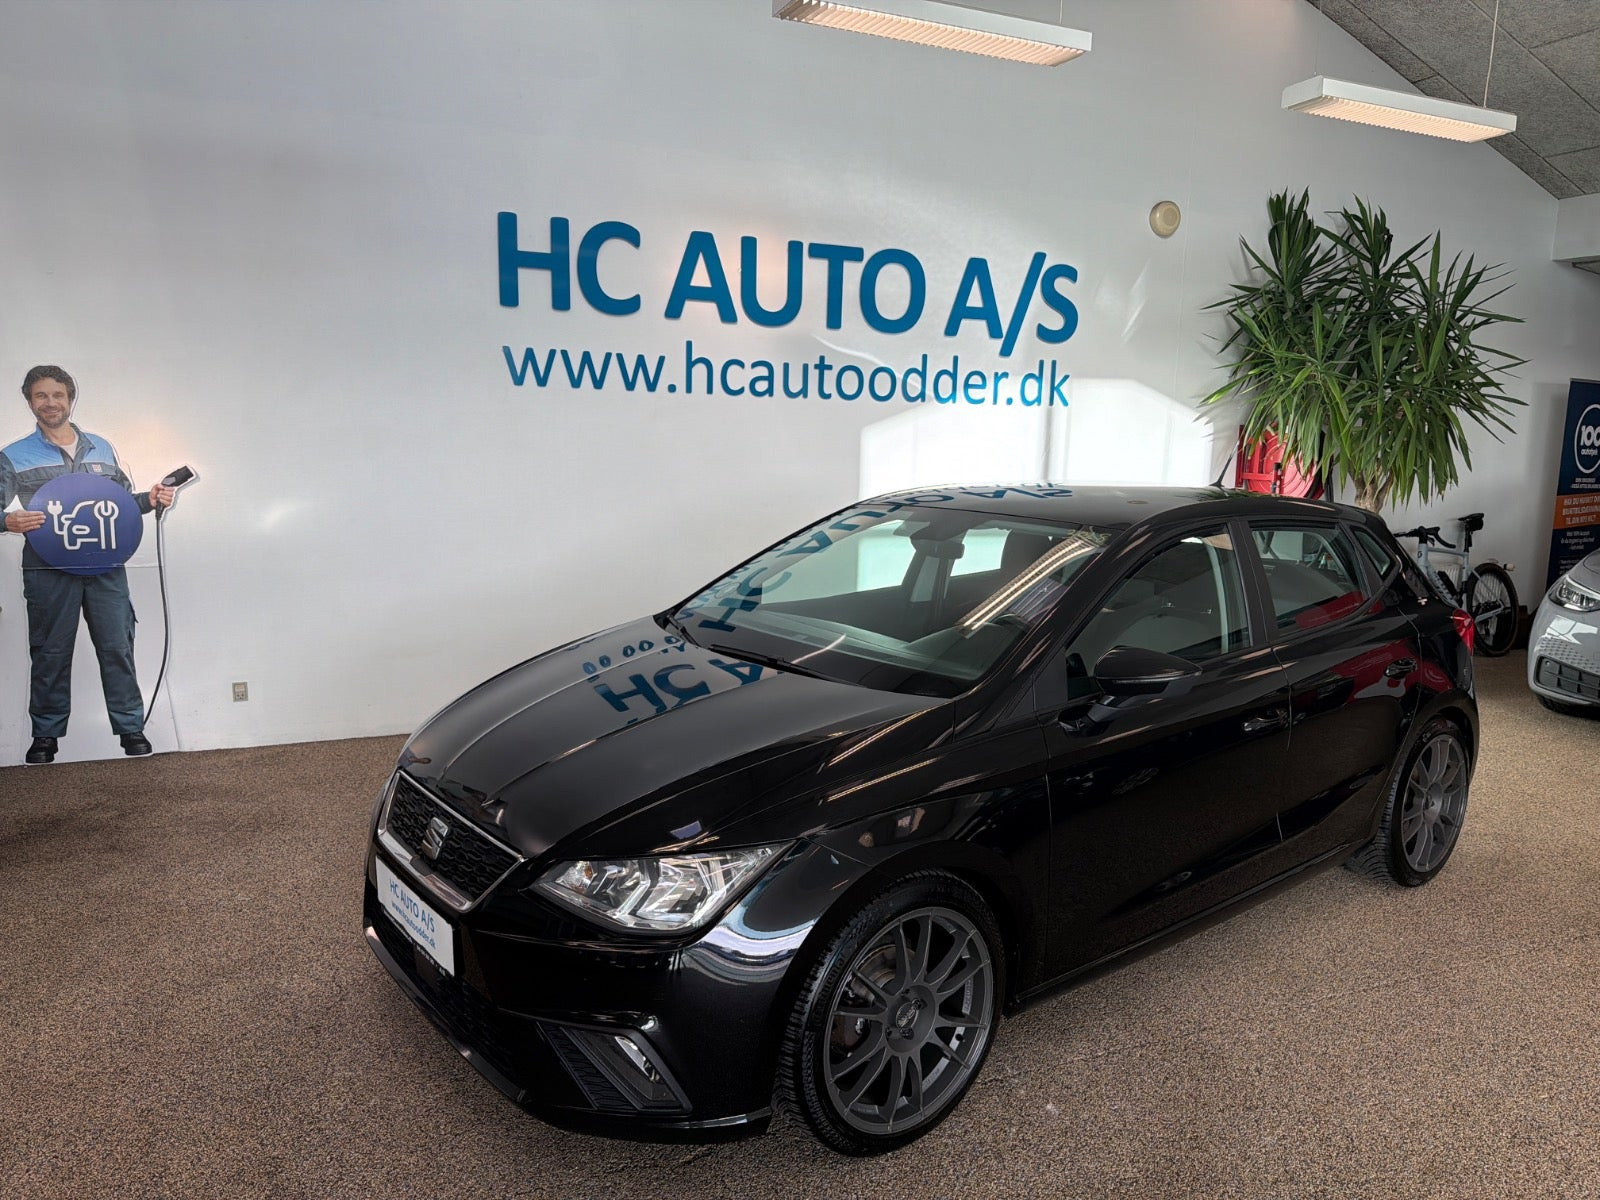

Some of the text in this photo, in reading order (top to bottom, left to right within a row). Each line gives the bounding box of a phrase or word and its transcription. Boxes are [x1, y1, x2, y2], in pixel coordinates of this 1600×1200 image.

[498, 211, 1078, 358] HC AUTO A/S
[503, 340, 1070, 407] www.hcautoodder.dk
[389, 879, 400, 898] HC
[400, 892, 419, 918] AUTO
[421, 910, 435, 933] A/S
